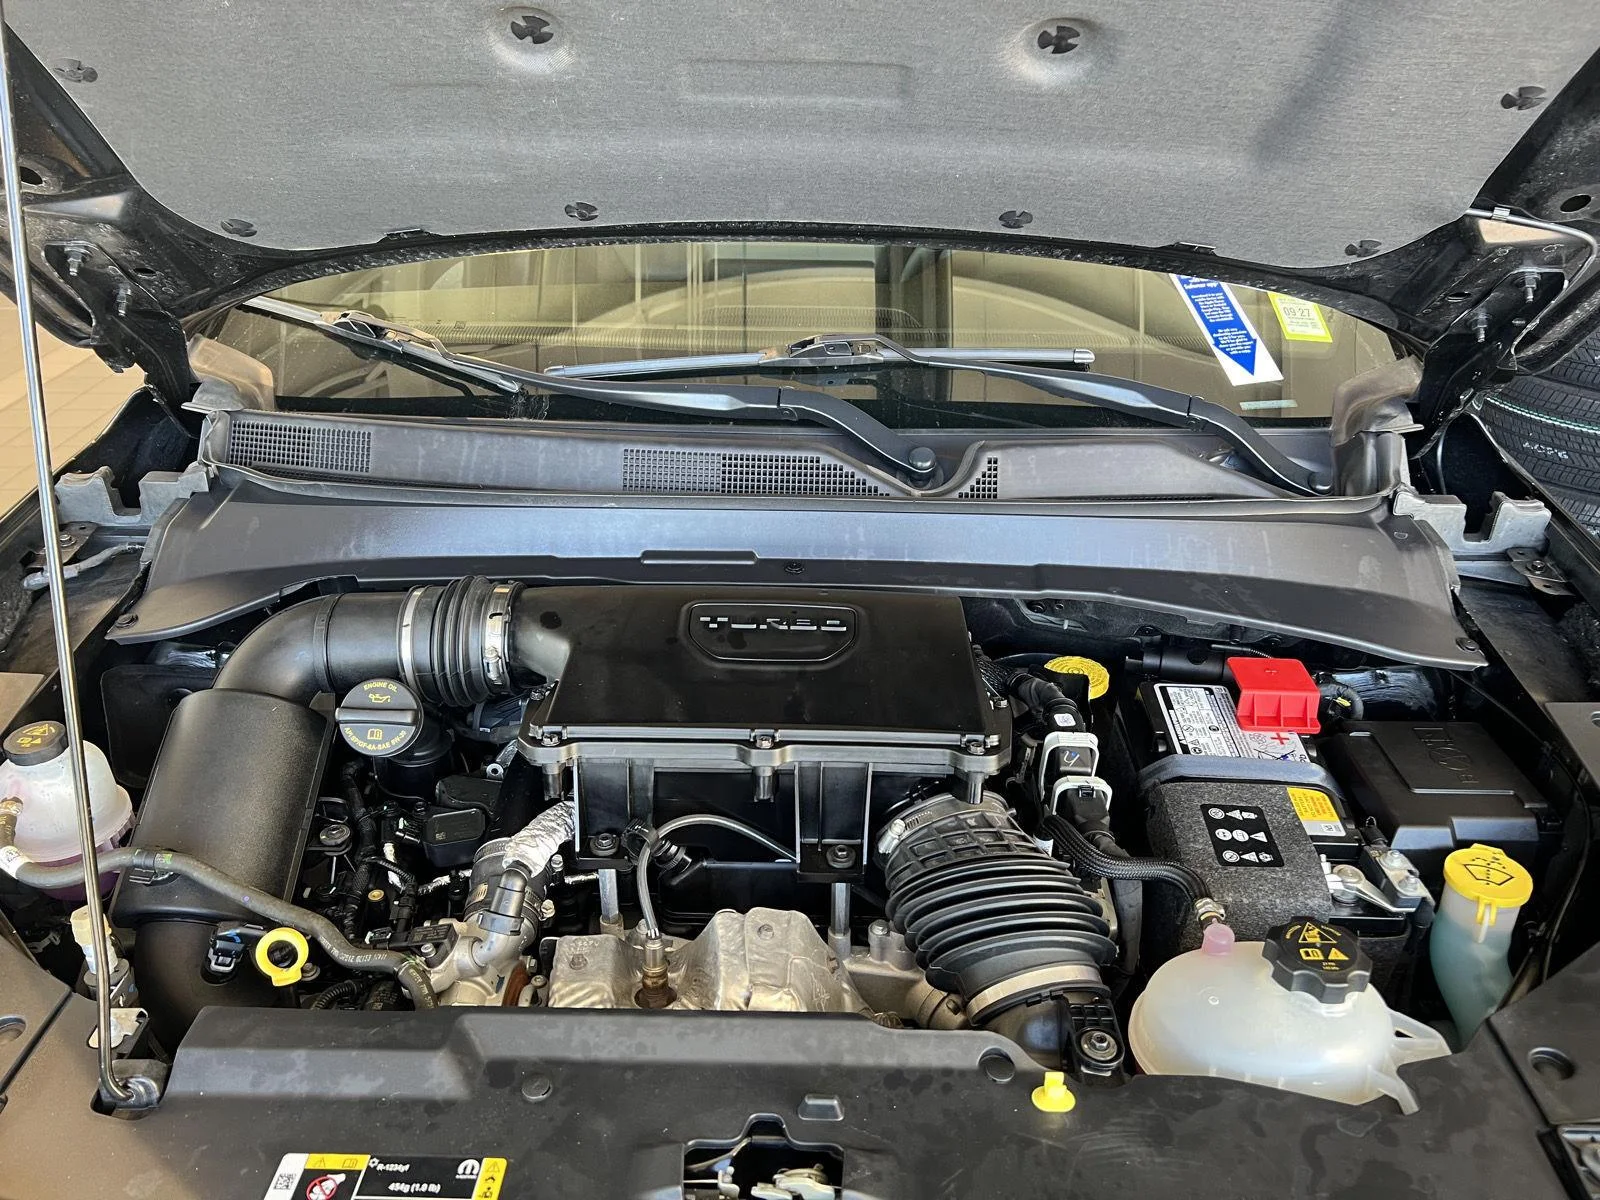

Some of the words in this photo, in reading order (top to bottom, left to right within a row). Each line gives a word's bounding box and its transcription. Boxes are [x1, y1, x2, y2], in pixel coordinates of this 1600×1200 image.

[699, 615, 848, 633] TURBO
[363, 682, 388, 691] ENGINE
[387, 682, 398, 693] OIL
